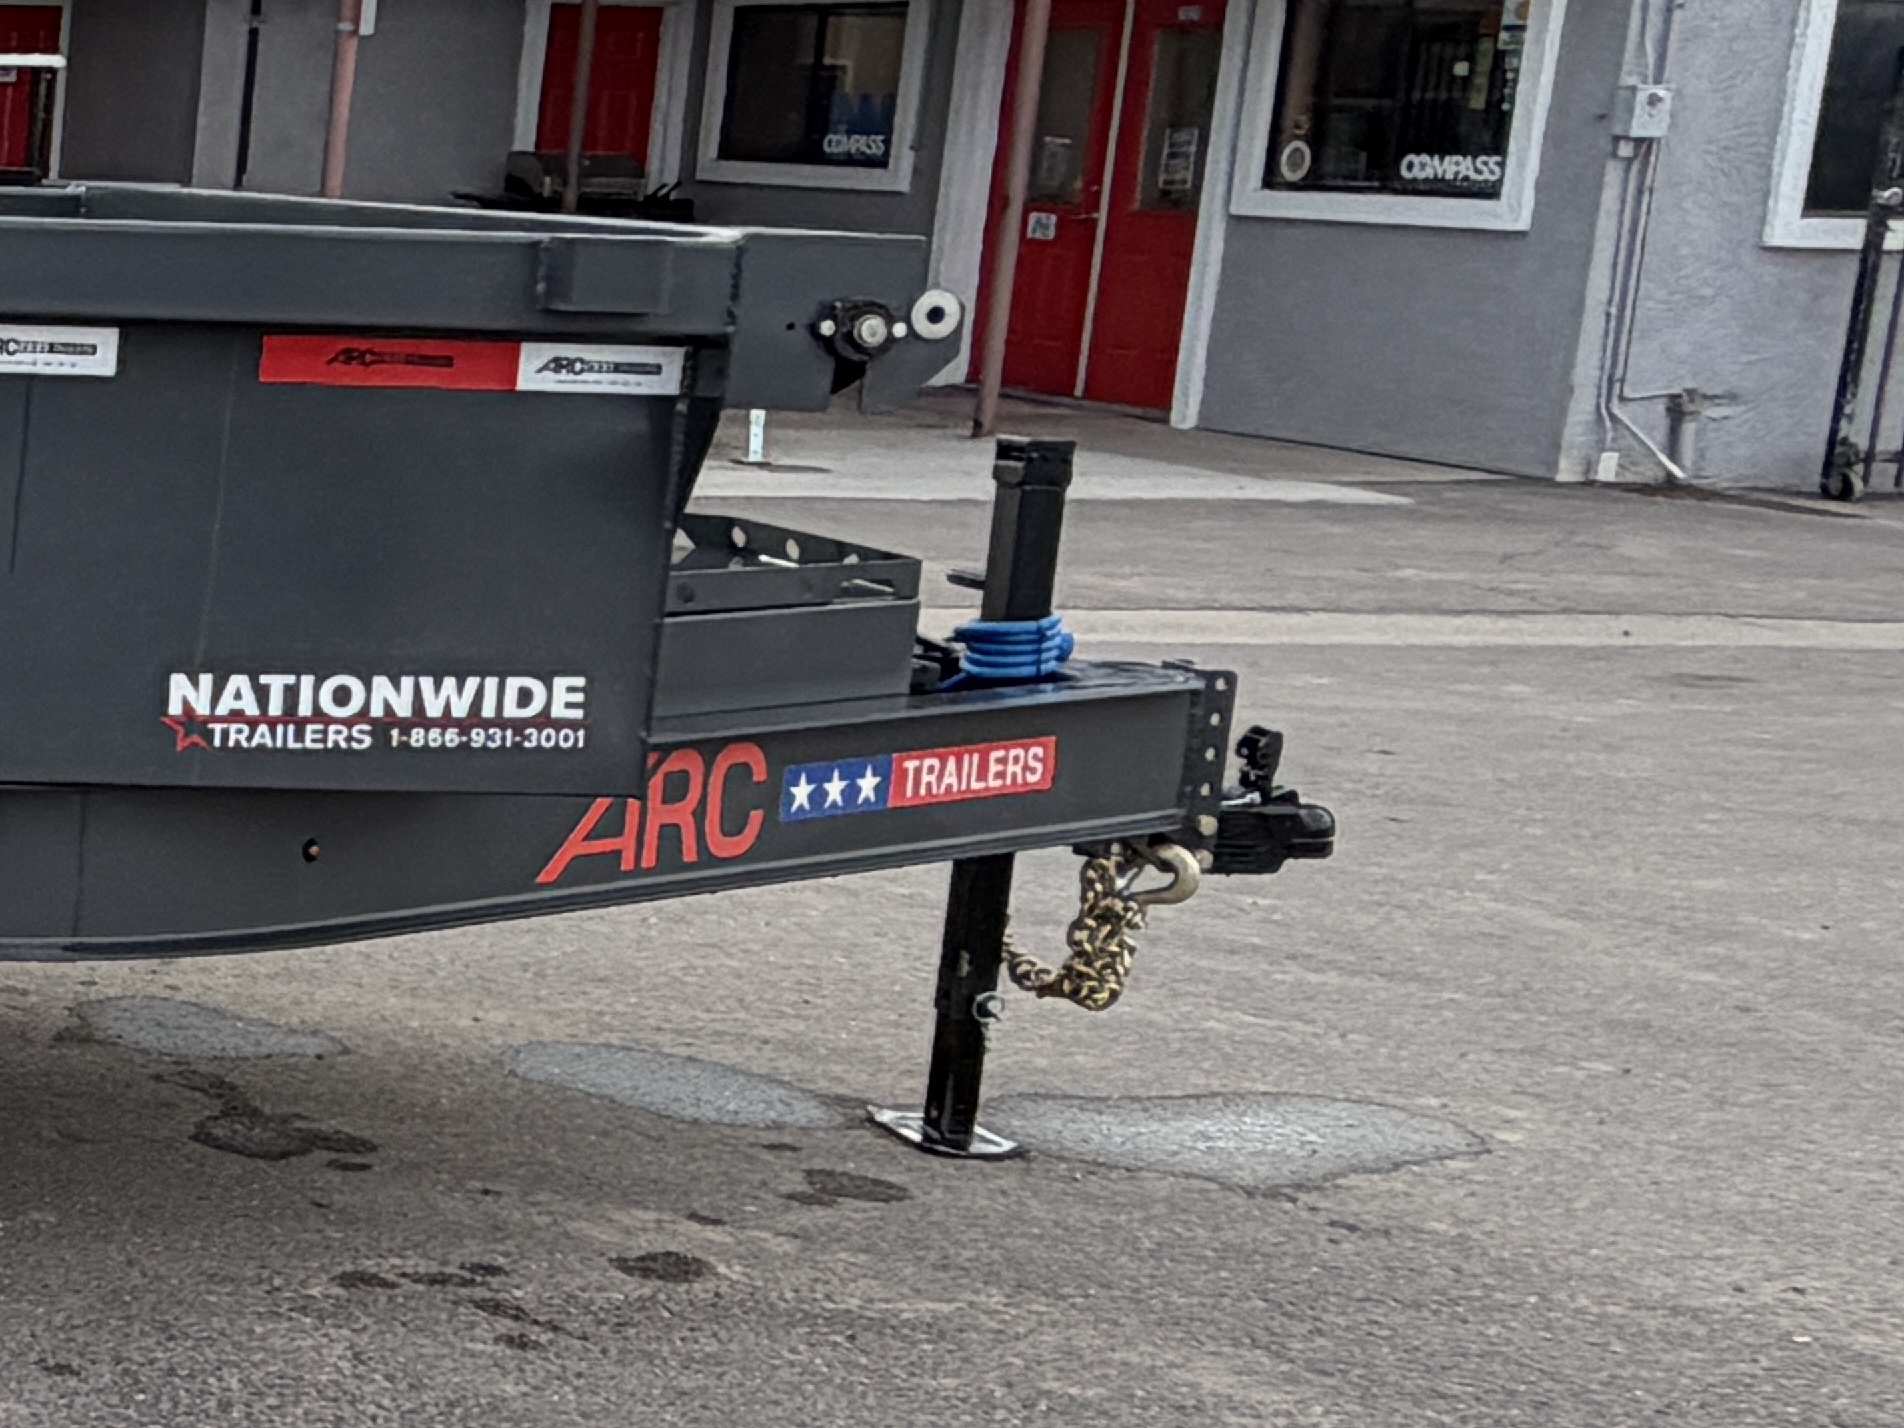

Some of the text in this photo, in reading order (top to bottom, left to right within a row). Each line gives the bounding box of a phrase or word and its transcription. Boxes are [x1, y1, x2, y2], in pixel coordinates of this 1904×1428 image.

[822, 134, 886, 156] COMPASS
[1400, 152, 1502, 181] COMPASS
[326, 348, 377, 368] ARC
[536, 356, 586, 376] ARC
[167, 673, 586, 720] NATIONWIDE
[208, 723, 586, 751] TRAILERS 1-866-931-3001
[535, 741, 1046, 884] ARC TRAILERS
